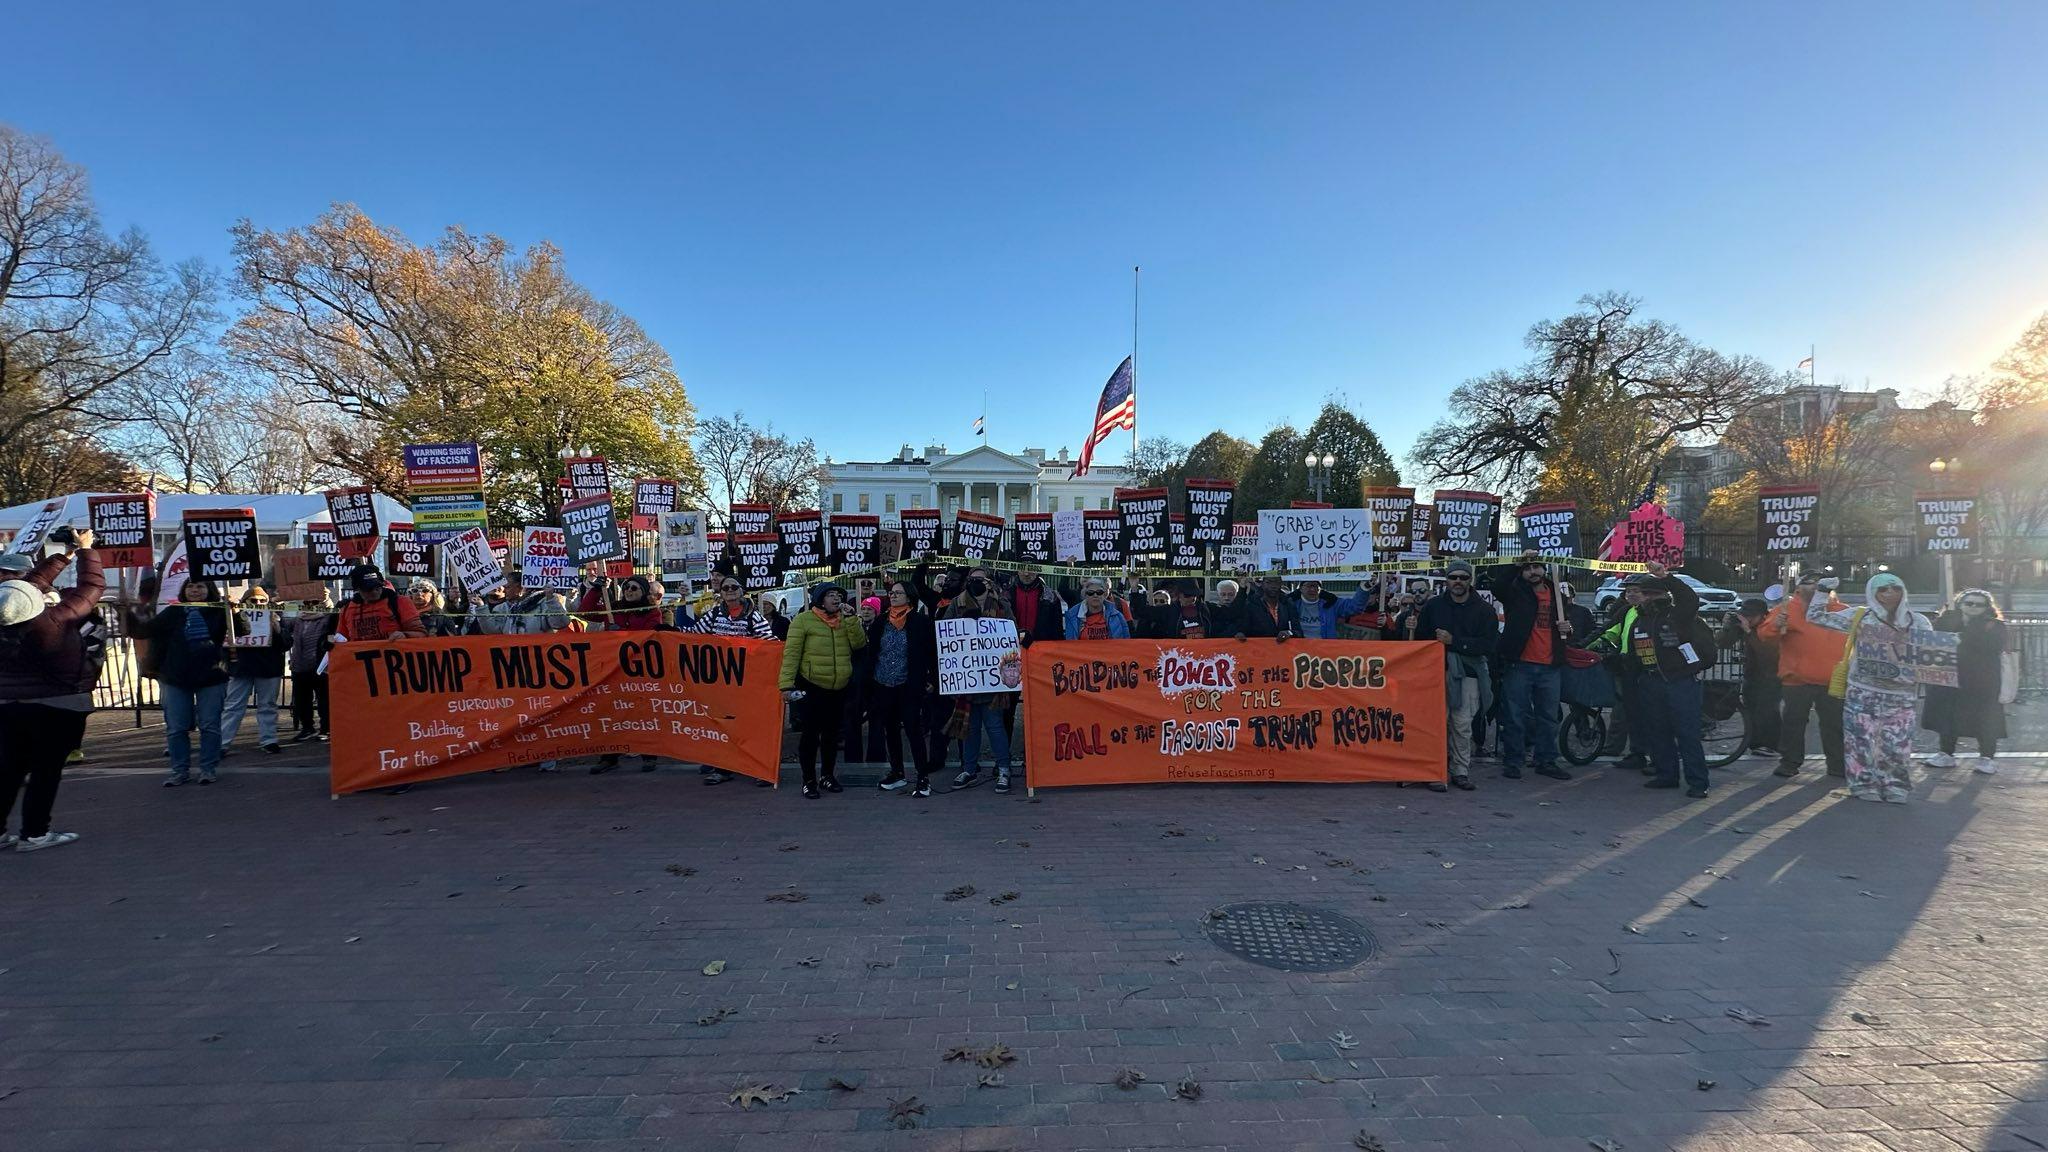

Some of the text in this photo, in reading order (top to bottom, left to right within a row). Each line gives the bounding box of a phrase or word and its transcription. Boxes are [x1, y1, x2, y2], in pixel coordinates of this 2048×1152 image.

[430, 456, 468, 465] FASCISM
[571, 463, 604, 476] ¡QUE SE
[572, 476, 606, 487] LARGUE
[639, 484, 674, 495] ¡QUE SE
[332, 493, 368, 510] ¡QUE SE
[638, 495, 674, 505] LARGUE
[1188, 490, 1232, 502] TRUMP
[1120, 500, 1166, 513] TRUMP
[1367, 498, 1412, 510] TRUMP
[1436, 501, 1488, 514] TRUMP
[1762, 496, 1818, 510] TRUMP
[1918, 501, 1974, 514] TRUMP
[95, 502, 145, 518] ¡QUE SE
[562, 504, 610, 524] TRUMP
[1192, 504, 1228, 515] MUST
[333, 508, 372, 524] LARGUE
[732, 512, 770, 522] TRUMP
[1126, 513, 1163, 526] MUST
[1200, 516, 1218, 528] GO
[1371, 511, 1407, 522] MUST
[1439, 514, 1482, 527] MUST
[1521, 512, 1574, 528] TRUMP
[1766, 510, 1812, 523] MUST
[1924, 513, 1968, 525] MUST
[95, 517, 146, 532] LARGUE
[187, 521, 252, 534] TRUMP
[338, 522, 372, 537] TRUMP
[570, 517, 608, 536] MUST
[736, 523, 766, 533] MUST
[780, 521, 820, 533] TRUMP
[903, 519, 940, 529] TRUMP
[958, 520, 1001, 538] TRUMP
[1017, 522, 1051, 531] TRUMP
[1342, 515, 1361, 534] by
[1379, 523, 1398, 535] GO
[1628, 520, 1665, 534] FUCK
[833, 526, 877, 538] TRUMP
[907, 529, 936, 539] MUST
[1020, 532, 1048, 541] MUST
[1090, 530, 1121, 540] MUST
[1135, 526, 1154, 538] GO
[1192, 528, 1226, 540] NOW!
[1447, 526, 1470, 539] GO
[1527, 524, 1570, 539] MUST
[1776, 524, 1800, 537] GO
[1936, 525, 1958, 537] GO
[196, 535, 248, 548] MUST
[582, 532, 602, 546] GO
[785, 532, 818, 544] MUST
[837, 538, 873, 550] MUST
[959, 534, 994, 549] MUST
[1130, 538, 1164, 550] NOW!
[1373, 536, 1406, 547] NOW!
[1538, 536, 1561, 548] GO
[1624, 532, 1665, 546] THIS
[1767, 536, 1809, 550] NOW!
[1928, 538, 1970, 550] NOW!
[394, 543, 428, 552] MUST
[444, 538, 462, 554] TAKE
[526, 545, 568, 556] SEXUA
[578, 541, 613, 560] NOW!
[738, 543, 778, 554] TRUMP
[794, 544, 811, 554] GO
[914, 540, 930, 549] GO
[1027, 542, 1042, 551] GO
[1097, 541, 1113, 550] GO
[1275, 538, 1294, 551] the
[1438, 540, 1479, 553] NOW!
[210, 549, 236, 562] GO
[454, 549, 469, 567] OUT
[470, 542, 480, 558] OF
[846, 551, 864, 562] GO
[964, 548, 982, 559] GO
[1092, 552, 1121, 561] NOW!
[1179, 546, 1196, 556] GO
[1222, 547, 1250, 555] FRIEND
[325, 555, 346, 565] GO
[402, 553, 420, 563] GO
[524, 556, 569, 566] PREDATO
[743, 555, 776, 566] MUST
[789, 554, 819, 566] NOW!
[1172, 556, 1202, 567] NOW!
[1566, 558, 1585, 567] CROSS
[202, 562, 250, 576] NOW!
[396, 563, 428, 573] NOW!
[466, 558, 482, 572] OUR
[1352, 564, 1367, 572] CRIME
[1599, 562, 1638, 571] CRIME SCENE
[541, 567, 563, 576] NOT
[751, 566, 768, 577] GO
[522, 575, 578, 587] PROTESTERS
[746, 577, 776, 588] NOW!
[939, 620, 1007, 638] HELL ISN'T
[941, 637, 1018, 654] HOT ENOUGH
[355, 640, 746, 697] TRUMP MUST GO NOW
[940, 657, 958, 670] FOR
[962, 656, 1000, 669] CHILD
[941, 668, 1000, 692] RAPISTS
[1051, 653, 1386, 697] BUILDING THE POWER OF THE PEOPLE
[448, 682, 661, 713] SURROUND THE HOUSE
[1184, 690, 1281, 714] FOR THE
[408, 700, 635, 740] Building the of the
[1053, 706, 1405, 762] FALL OF THE FASCIST TRUMP REGIME
[380, 717, 729, 771] For the Trump Fascist Regime
[1168, 766, 1275, 780] RefuseFascism.org
